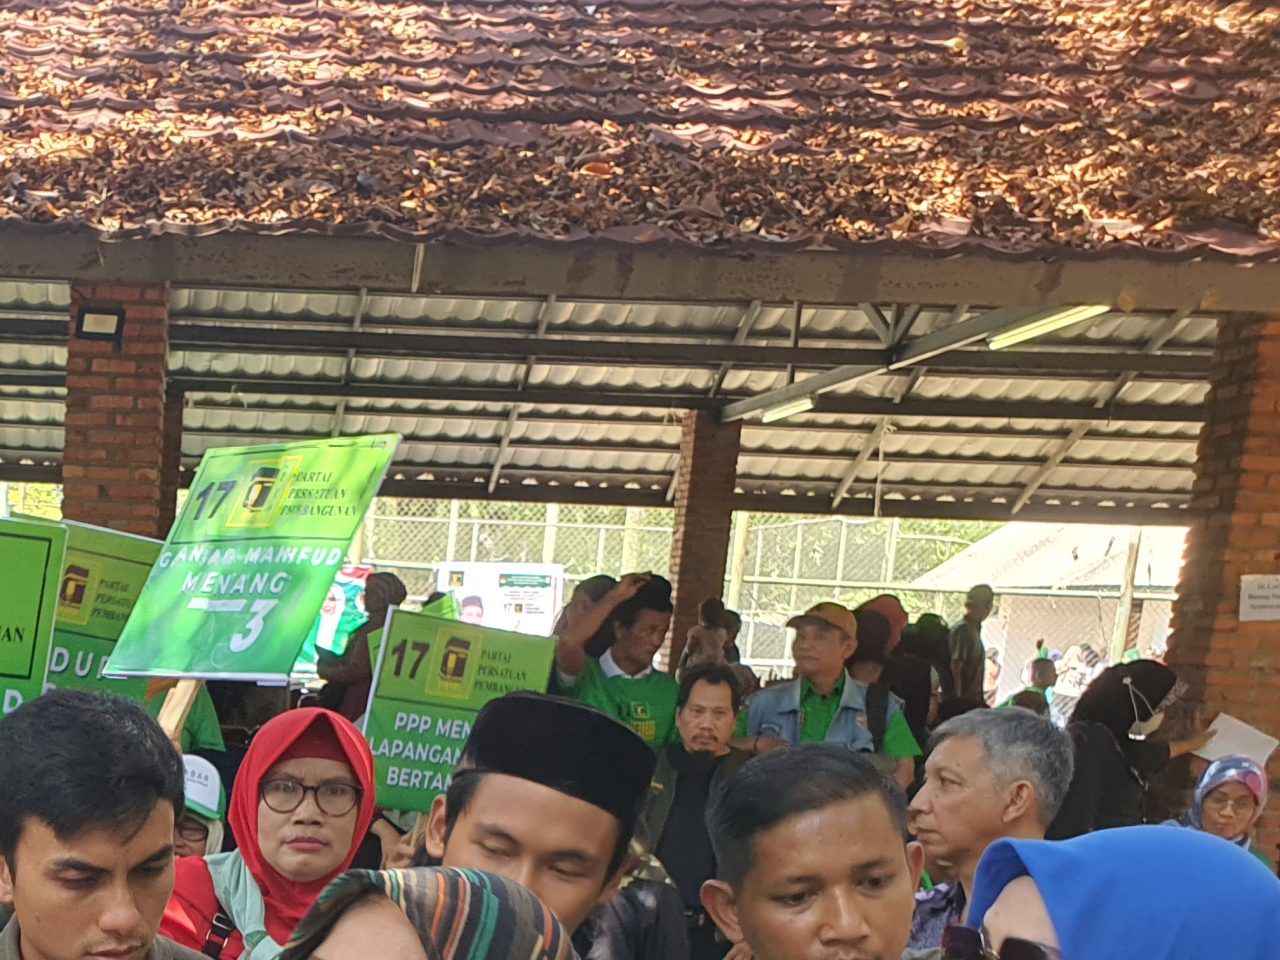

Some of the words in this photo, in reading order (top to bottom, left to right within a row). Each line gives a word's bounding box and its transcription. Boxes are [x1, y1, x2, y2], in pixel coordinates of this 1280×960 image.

[193, 480, 237, 521] 17
[181, 570, 289, 594] MENANG
[229, 599, 279, 653] 3
[391, 638, 430, 680] 17
[394, 711, 432, 734] PPP
[435, 718, 471, 739] MEN
